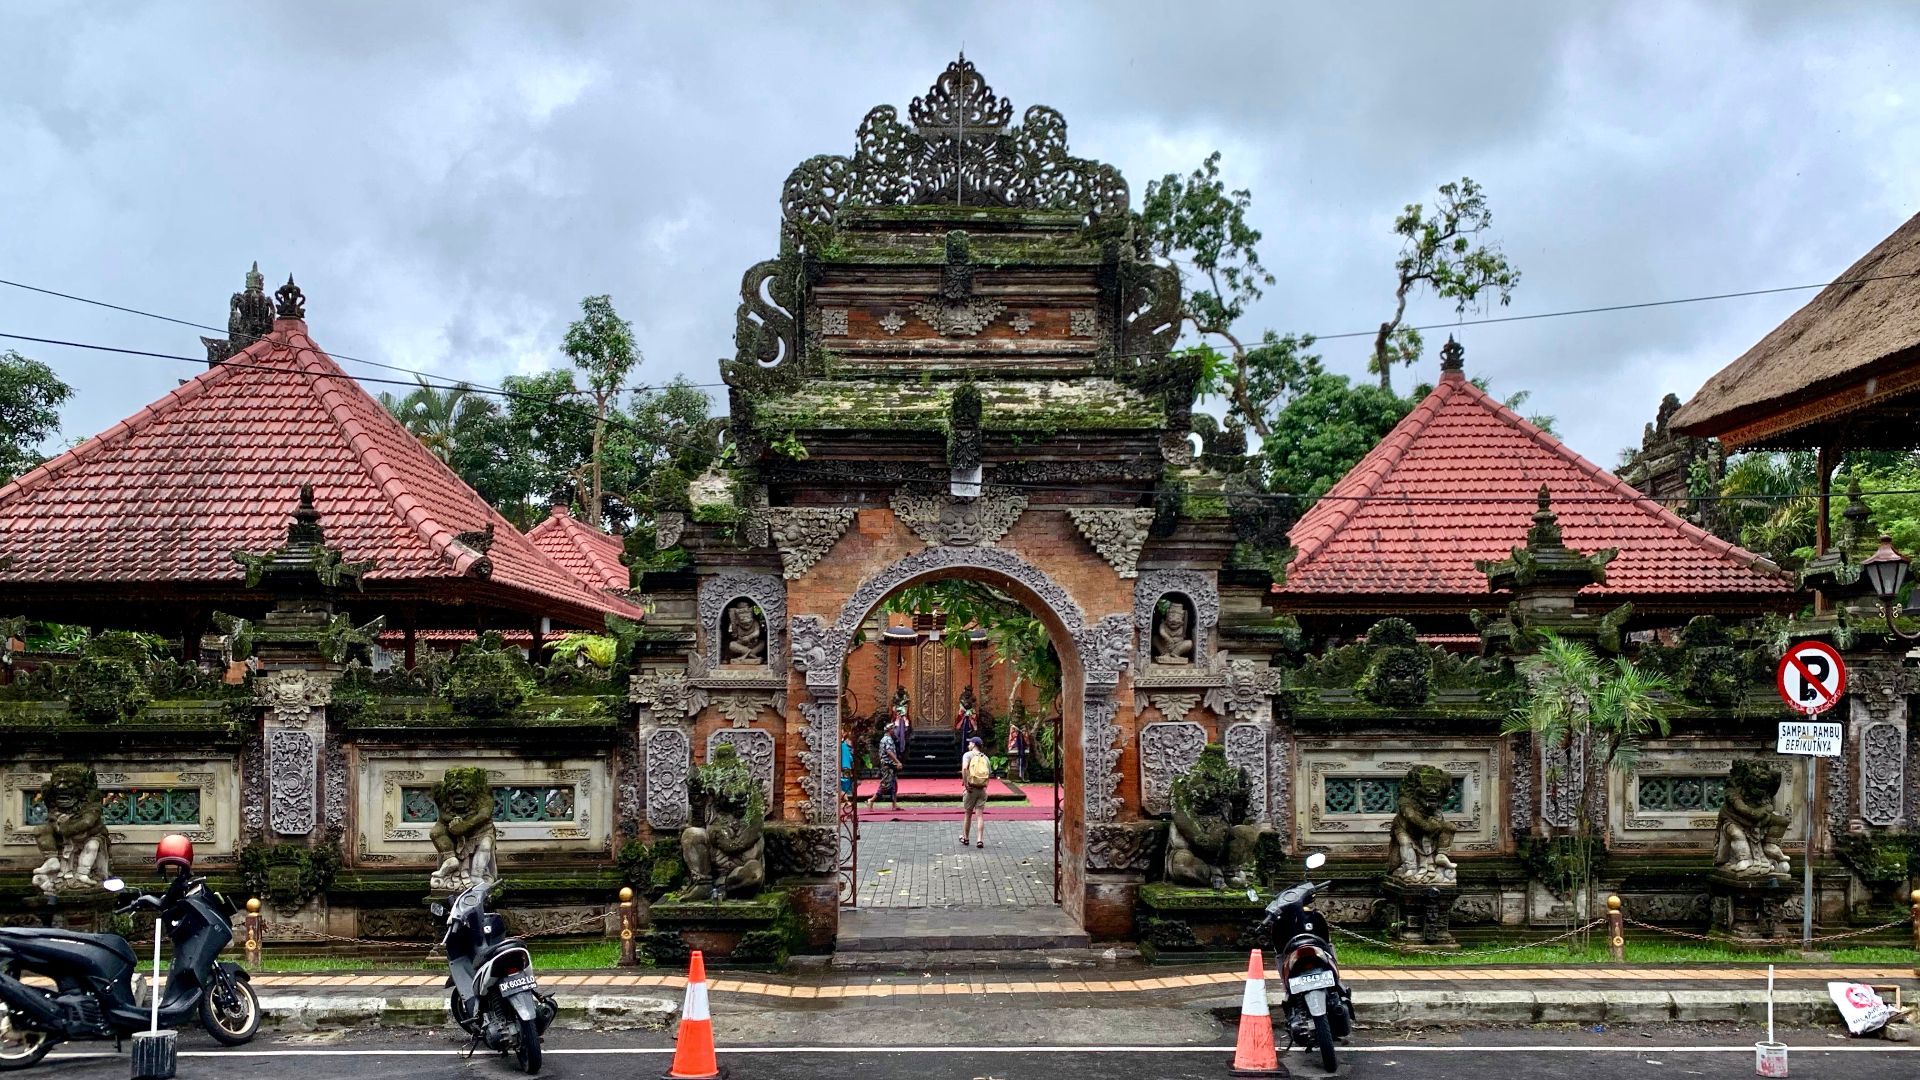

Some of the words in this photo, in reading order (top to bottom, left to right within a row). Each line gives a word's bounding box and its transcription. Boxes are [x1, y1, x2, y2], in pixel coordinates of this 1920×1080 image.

[1800, 656, 1830, 701] P
[1782, 725, 1809, 737] SAMPAI
[1813, 725, 1839, 738] RAMBU
[1785, 739, 1831, 751] BERIKUTNYA
[499, 981, 509, 991] DK
[509, 978, 526, 988] 6032
